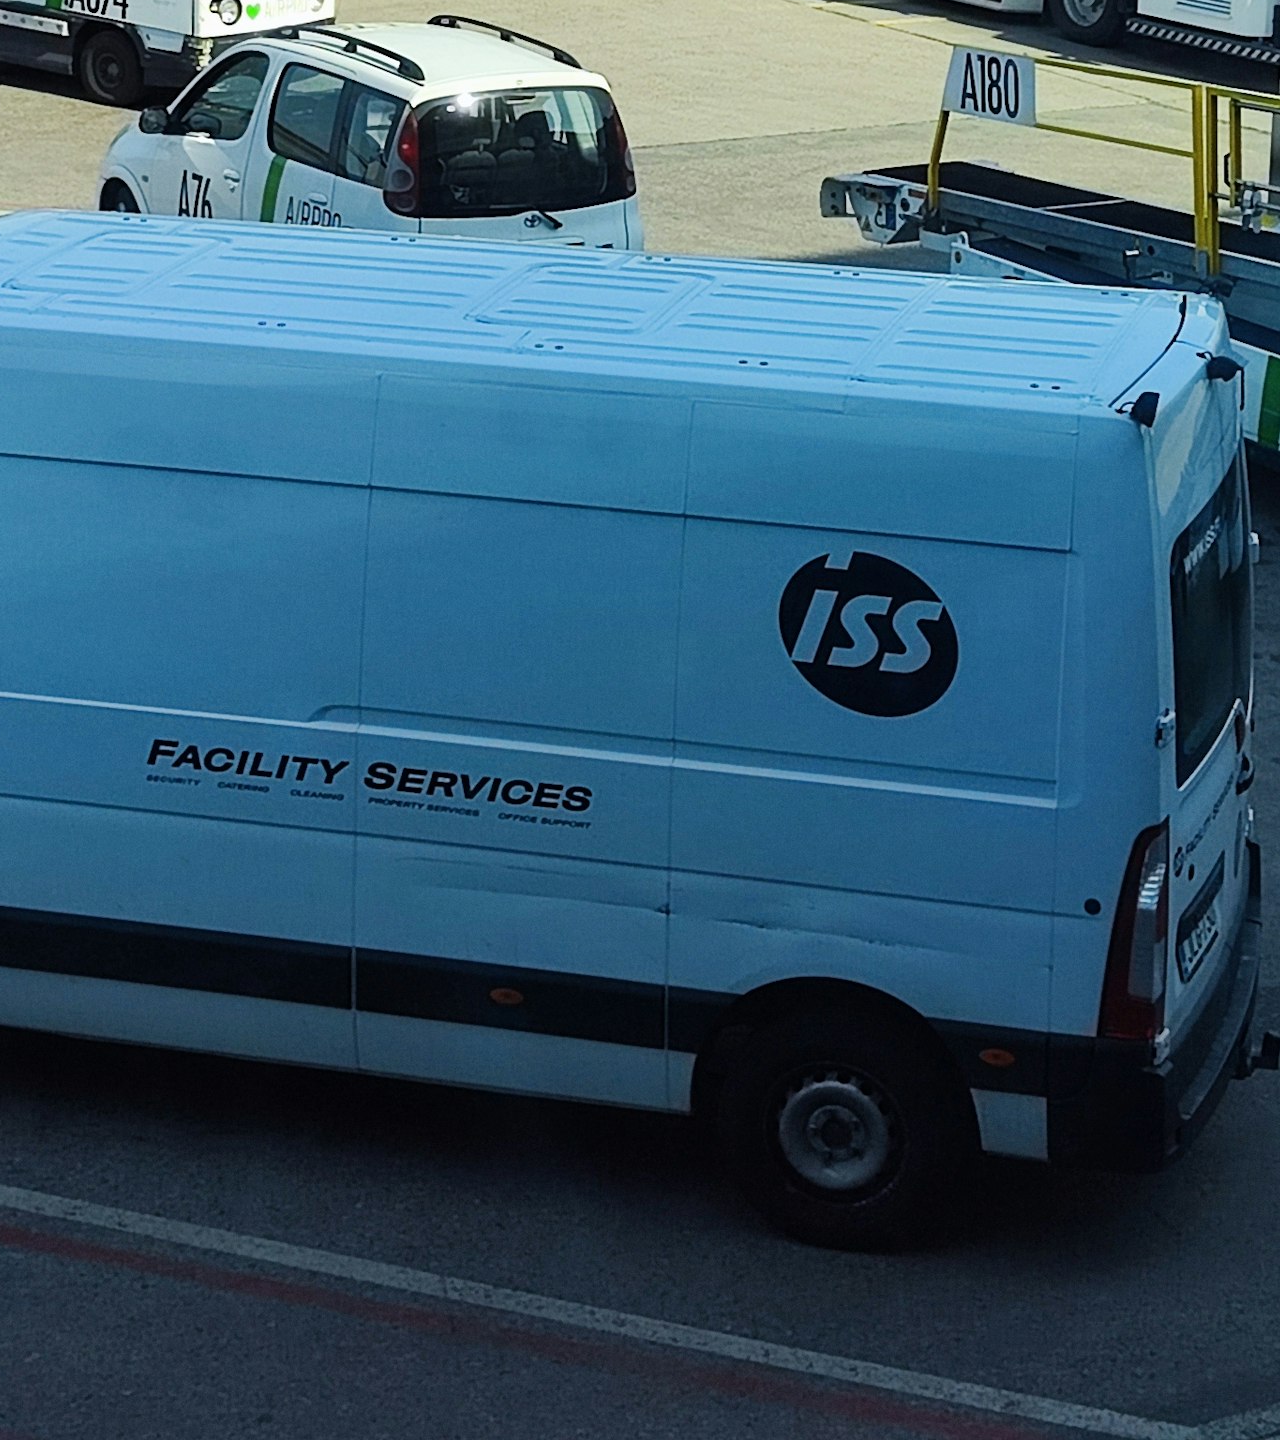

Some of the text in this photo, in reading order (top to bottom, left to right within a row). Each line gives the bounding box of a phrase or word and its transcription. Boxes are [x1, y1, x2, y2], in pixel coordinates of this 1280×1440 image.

[959, 52, 1020, 120] A180
[178, 169, 213, 218] A76
[146, 739, 594, 812] FACILITY SERVICES
[146, 774, 345, 802] SECURITY CATERING CLEANING
[368, 797, 592, 831] PROPERTY SERVICES OFFICE SUPPORT
